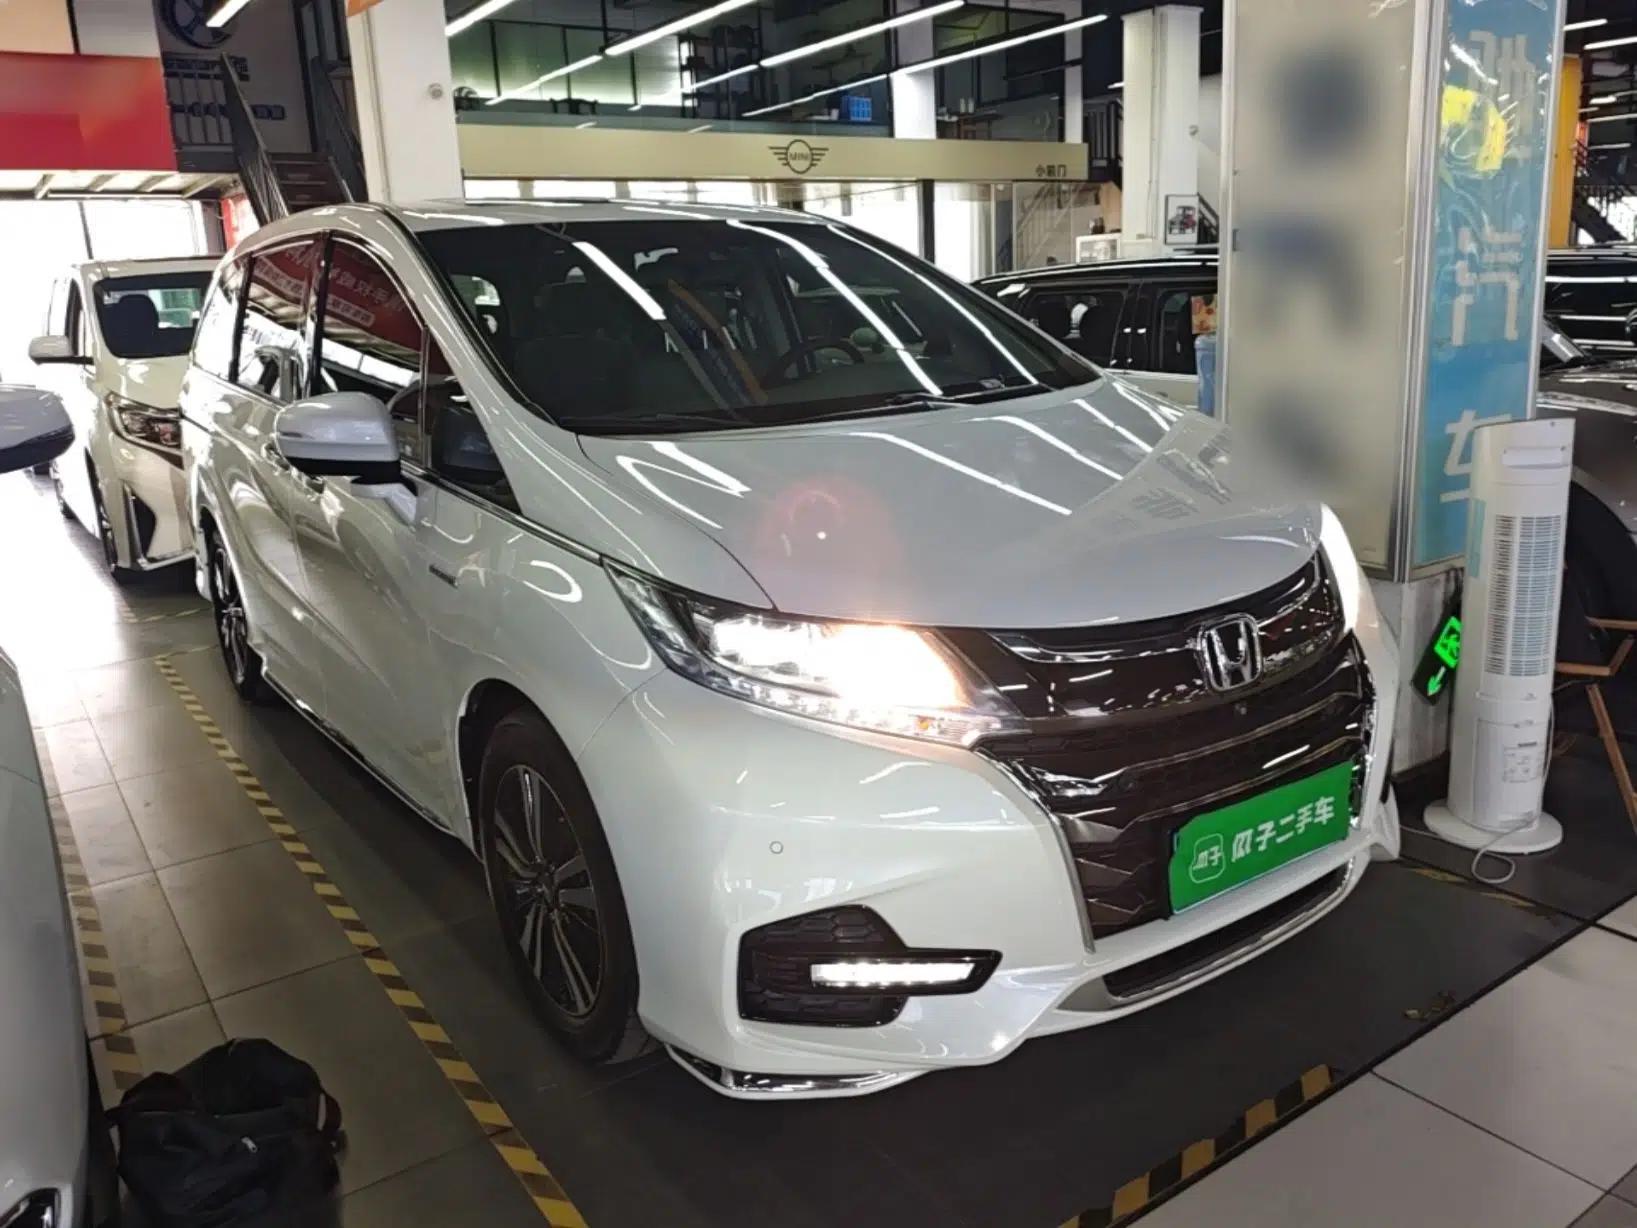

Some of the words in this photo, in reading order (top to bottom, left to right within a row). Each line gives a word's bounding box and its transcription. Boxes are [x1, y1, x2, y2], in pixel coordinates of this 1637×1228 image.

[1231, 796, 1335, 863] 瓜子二手车
